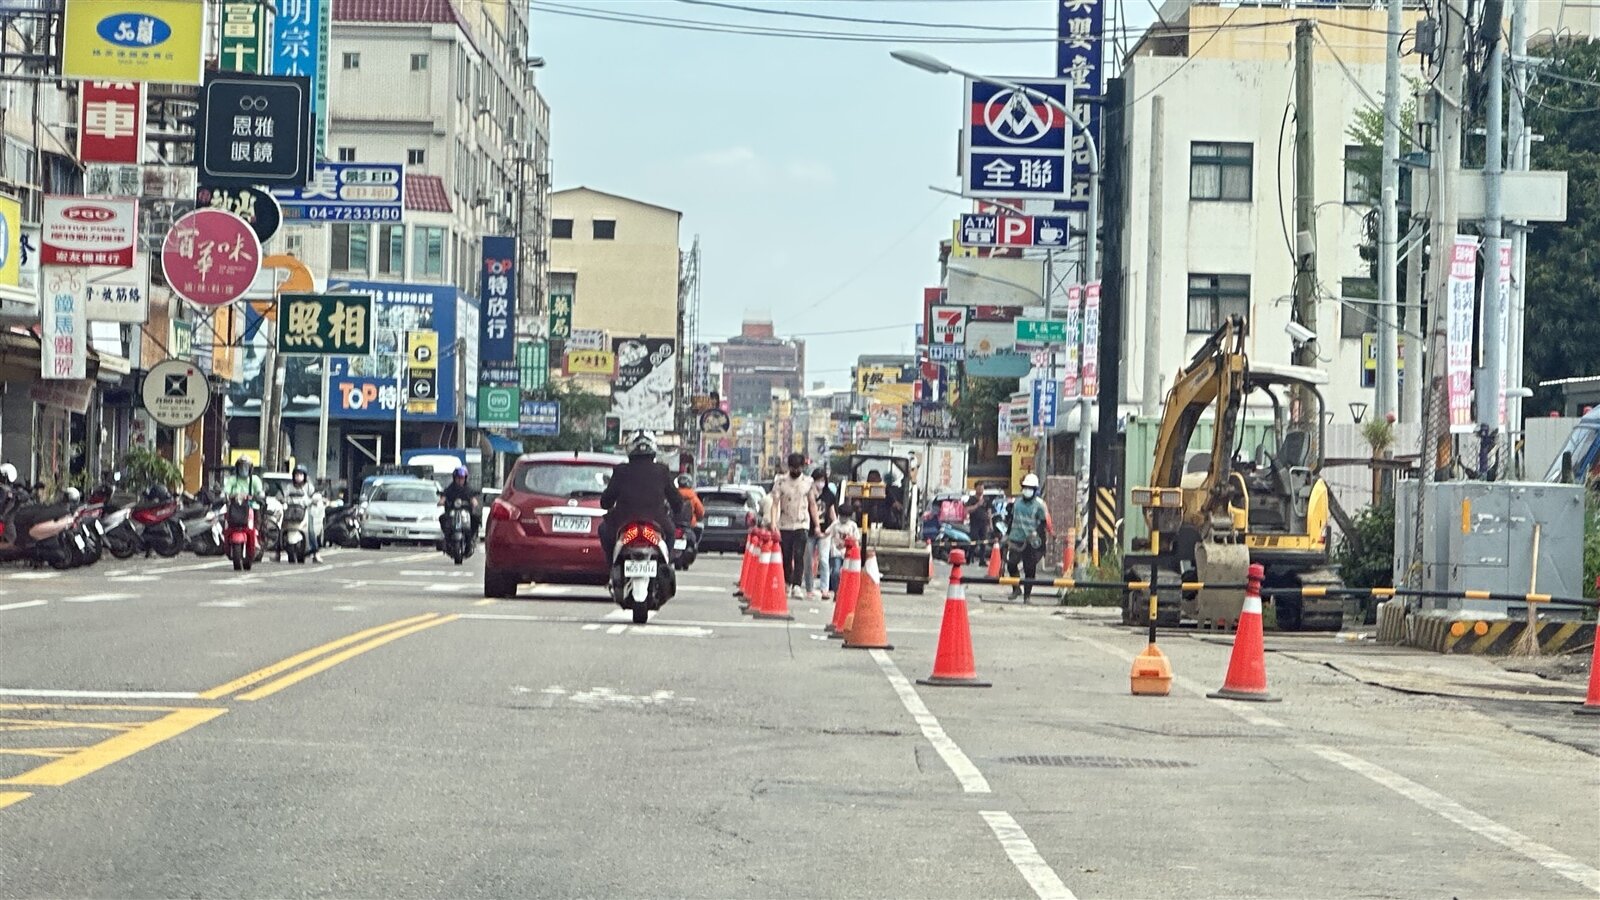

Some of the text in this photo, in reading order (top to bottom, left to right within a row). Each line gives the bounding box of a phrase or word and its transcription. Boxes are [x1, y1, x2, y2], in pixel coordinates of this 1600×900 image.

[231, 141, 273, 163] 眼鏡
[983, 158, 1052, 188] 全聯
[68, 210, 109, 219] PGO
[965, 217, 995, 229] ATM
[1005, 219, 1026, 243] P
[485, 257, 512, 273] TOP
[487, 275, 508, 339] 特欣行
[285, 301, 366, 349] 照相
[418, 347, 430, 361] P
[339, 383, 377, 409] TOP
